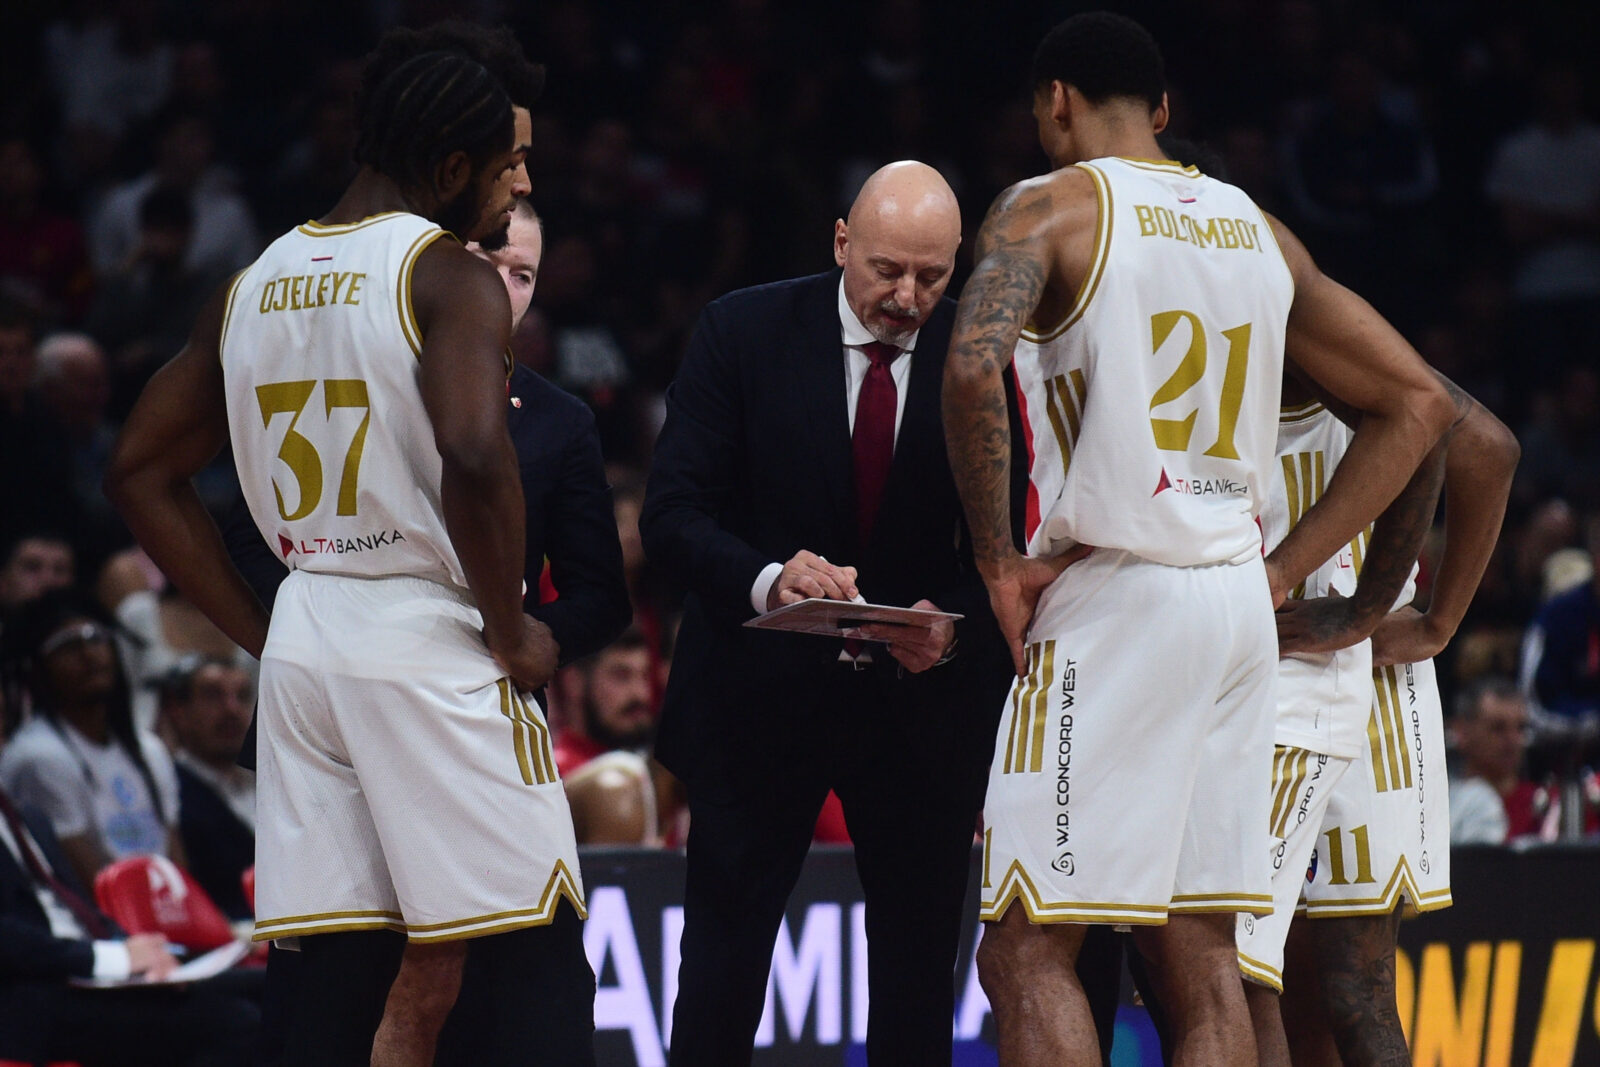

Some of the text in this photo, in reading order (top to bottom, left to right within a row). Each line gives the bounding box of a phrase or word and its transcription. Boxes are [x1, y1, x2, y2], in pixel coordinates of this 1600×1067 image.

[1133, 205, 1263, 253] BOLOMBOY
[260, 271, 367, 314] OJELEYE
[1150, 310, 1252, 460] 21
[255, 379, 371, 521] 37
[1405, 664, 1417, 706] WES
[1056, 658, 1077, 847] W.D. CONCORD WEST
[1411, 710, 1425, 804] CONCORD
[982, 827, 993, 888] 1
[1323, 825, 1377, 885] 11
